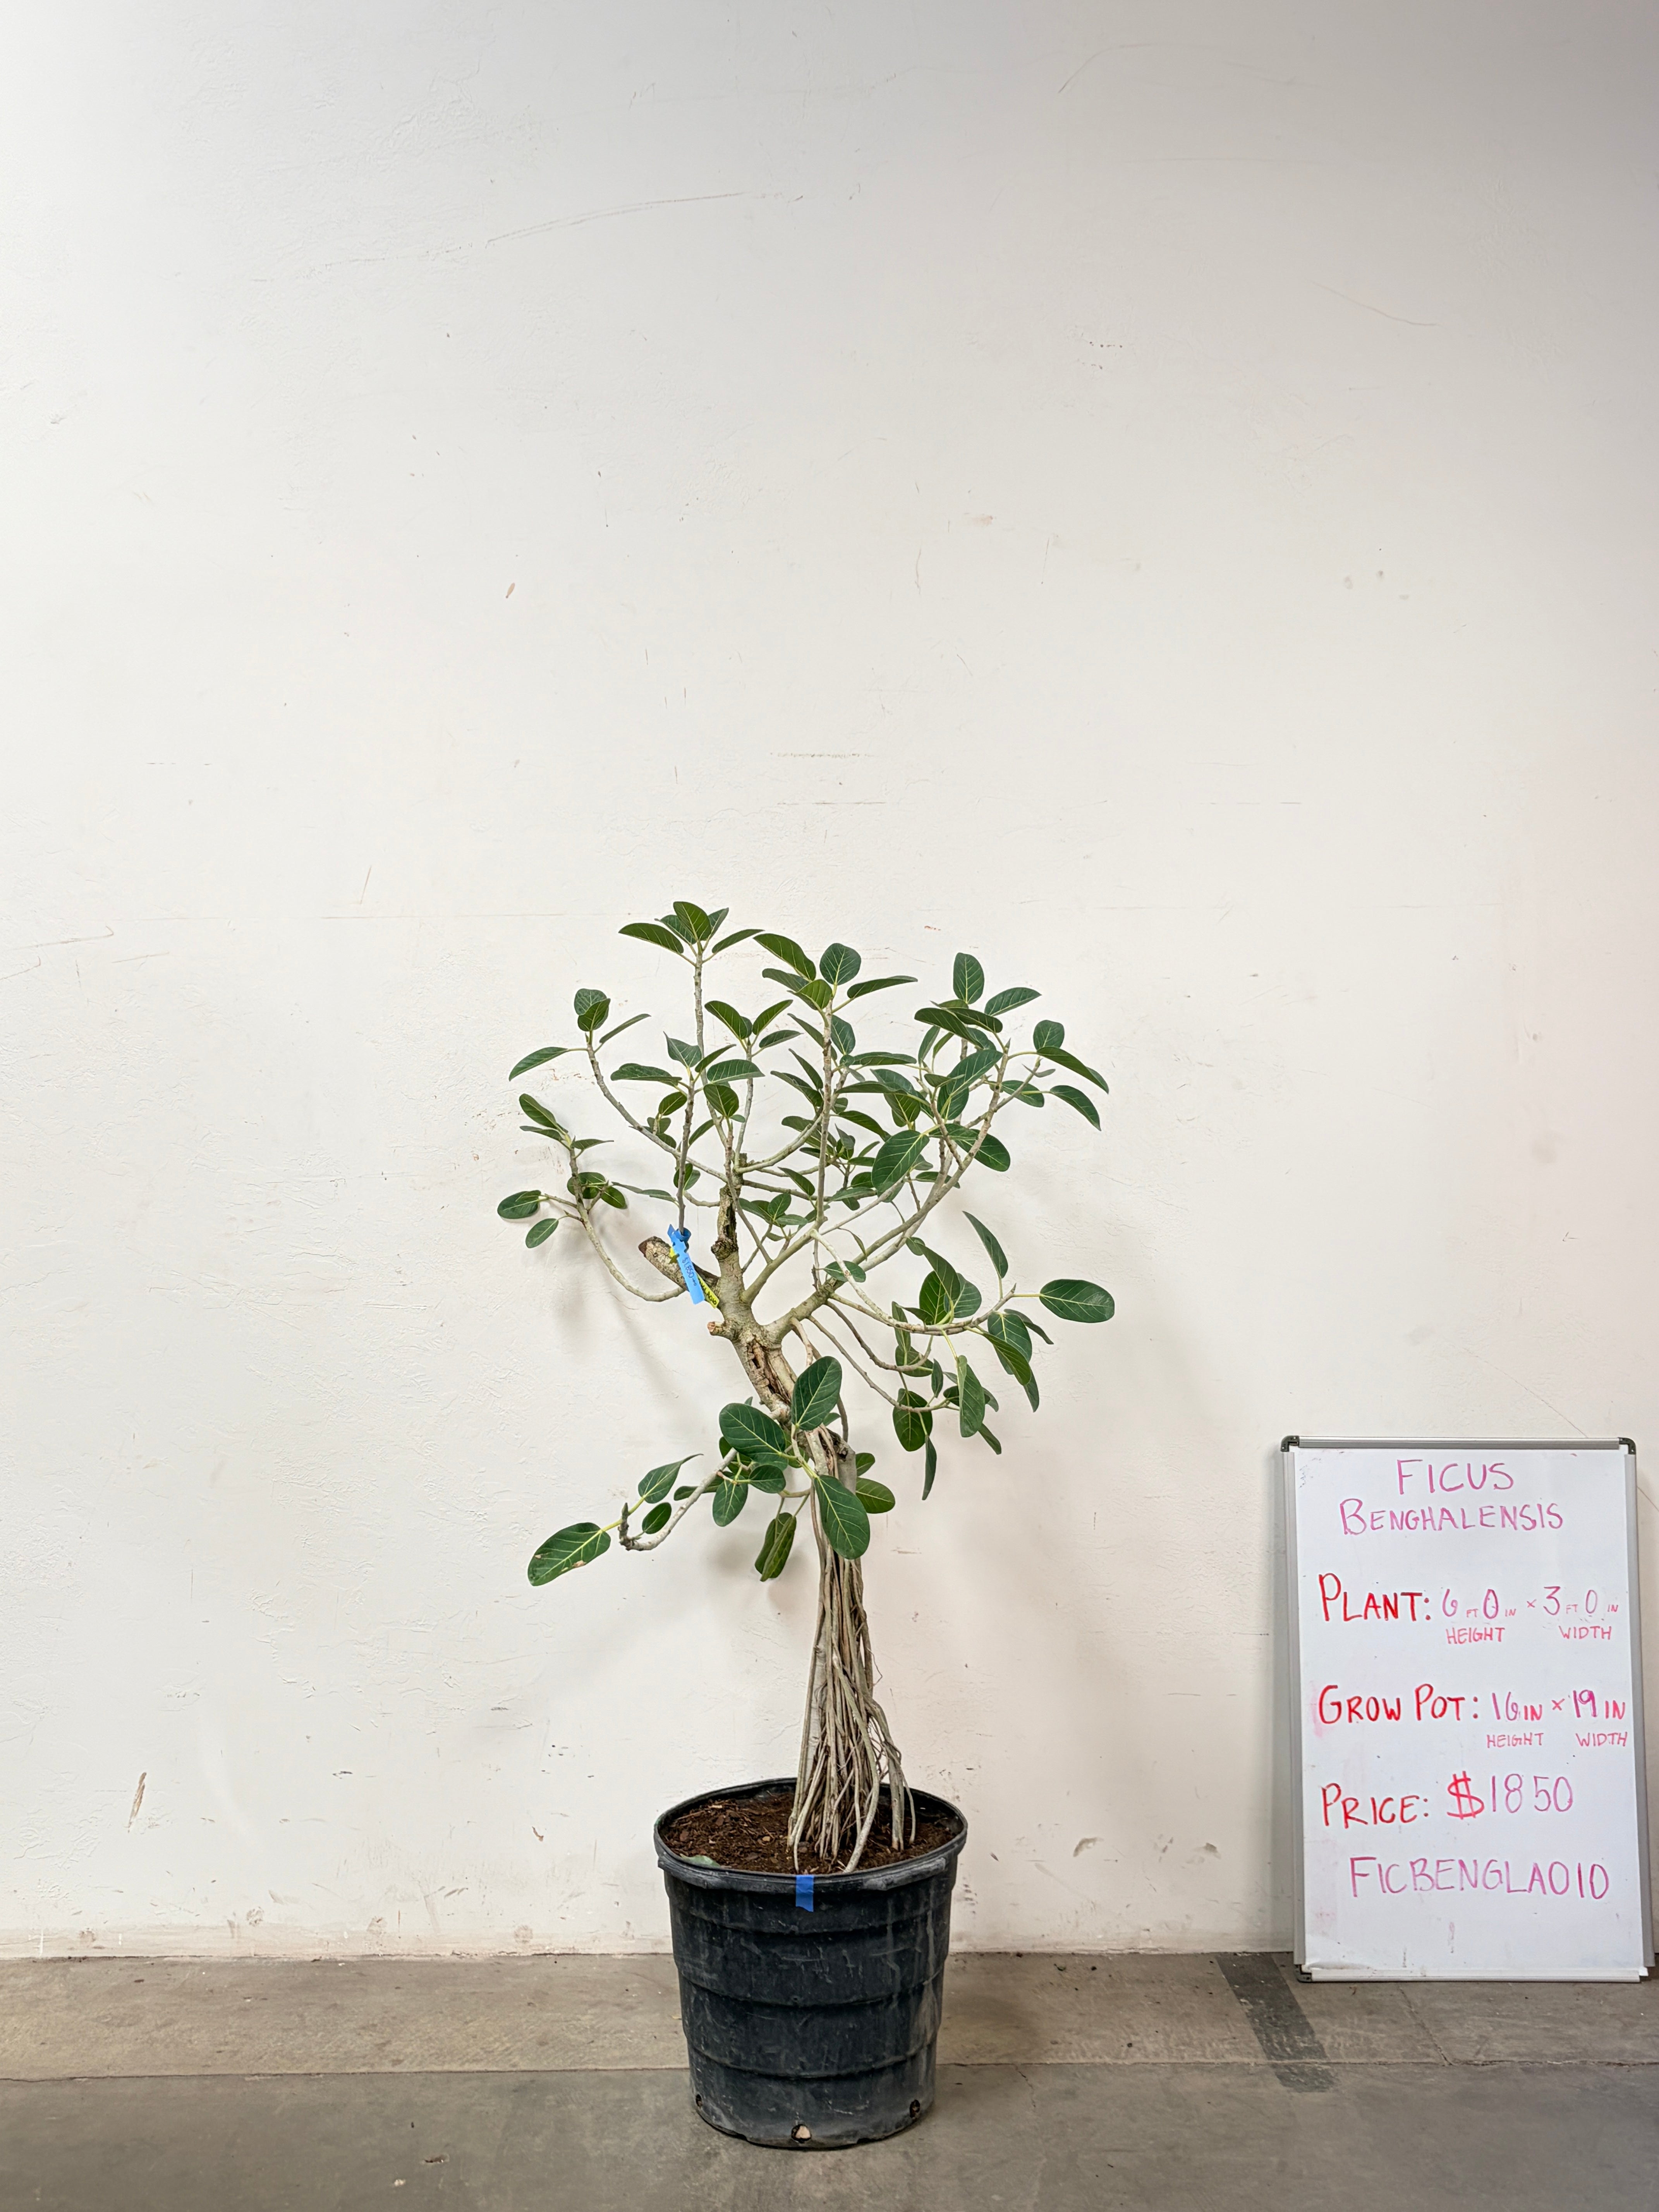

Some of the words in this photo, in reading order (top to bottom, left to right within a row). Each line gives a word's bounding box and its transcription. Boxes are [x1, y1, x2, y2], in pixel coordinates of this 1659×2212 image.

[1397, 1460, 1513, 1495] FICUS
[1340, 1499, 1563, 1535] BENGHALENSIS
[1318, 1573, 1431, 1622] PLANT:
[1446, 1627, 1504, 1645] HEIGHT
[1559, 1626, 1612, 1640] WIDTH
[1318, 1685, 1401, 1724] GROW
[1414, 1683, 1478, 1721] POT:
[1486, 1733, 1543, 1748] HEIGHT
[1576, 1732, 1627, 1747] WIDTH
[1321, 1783, 1428, 1829] PRICE:
[1446, 1771, 1573, 1820] $1850
